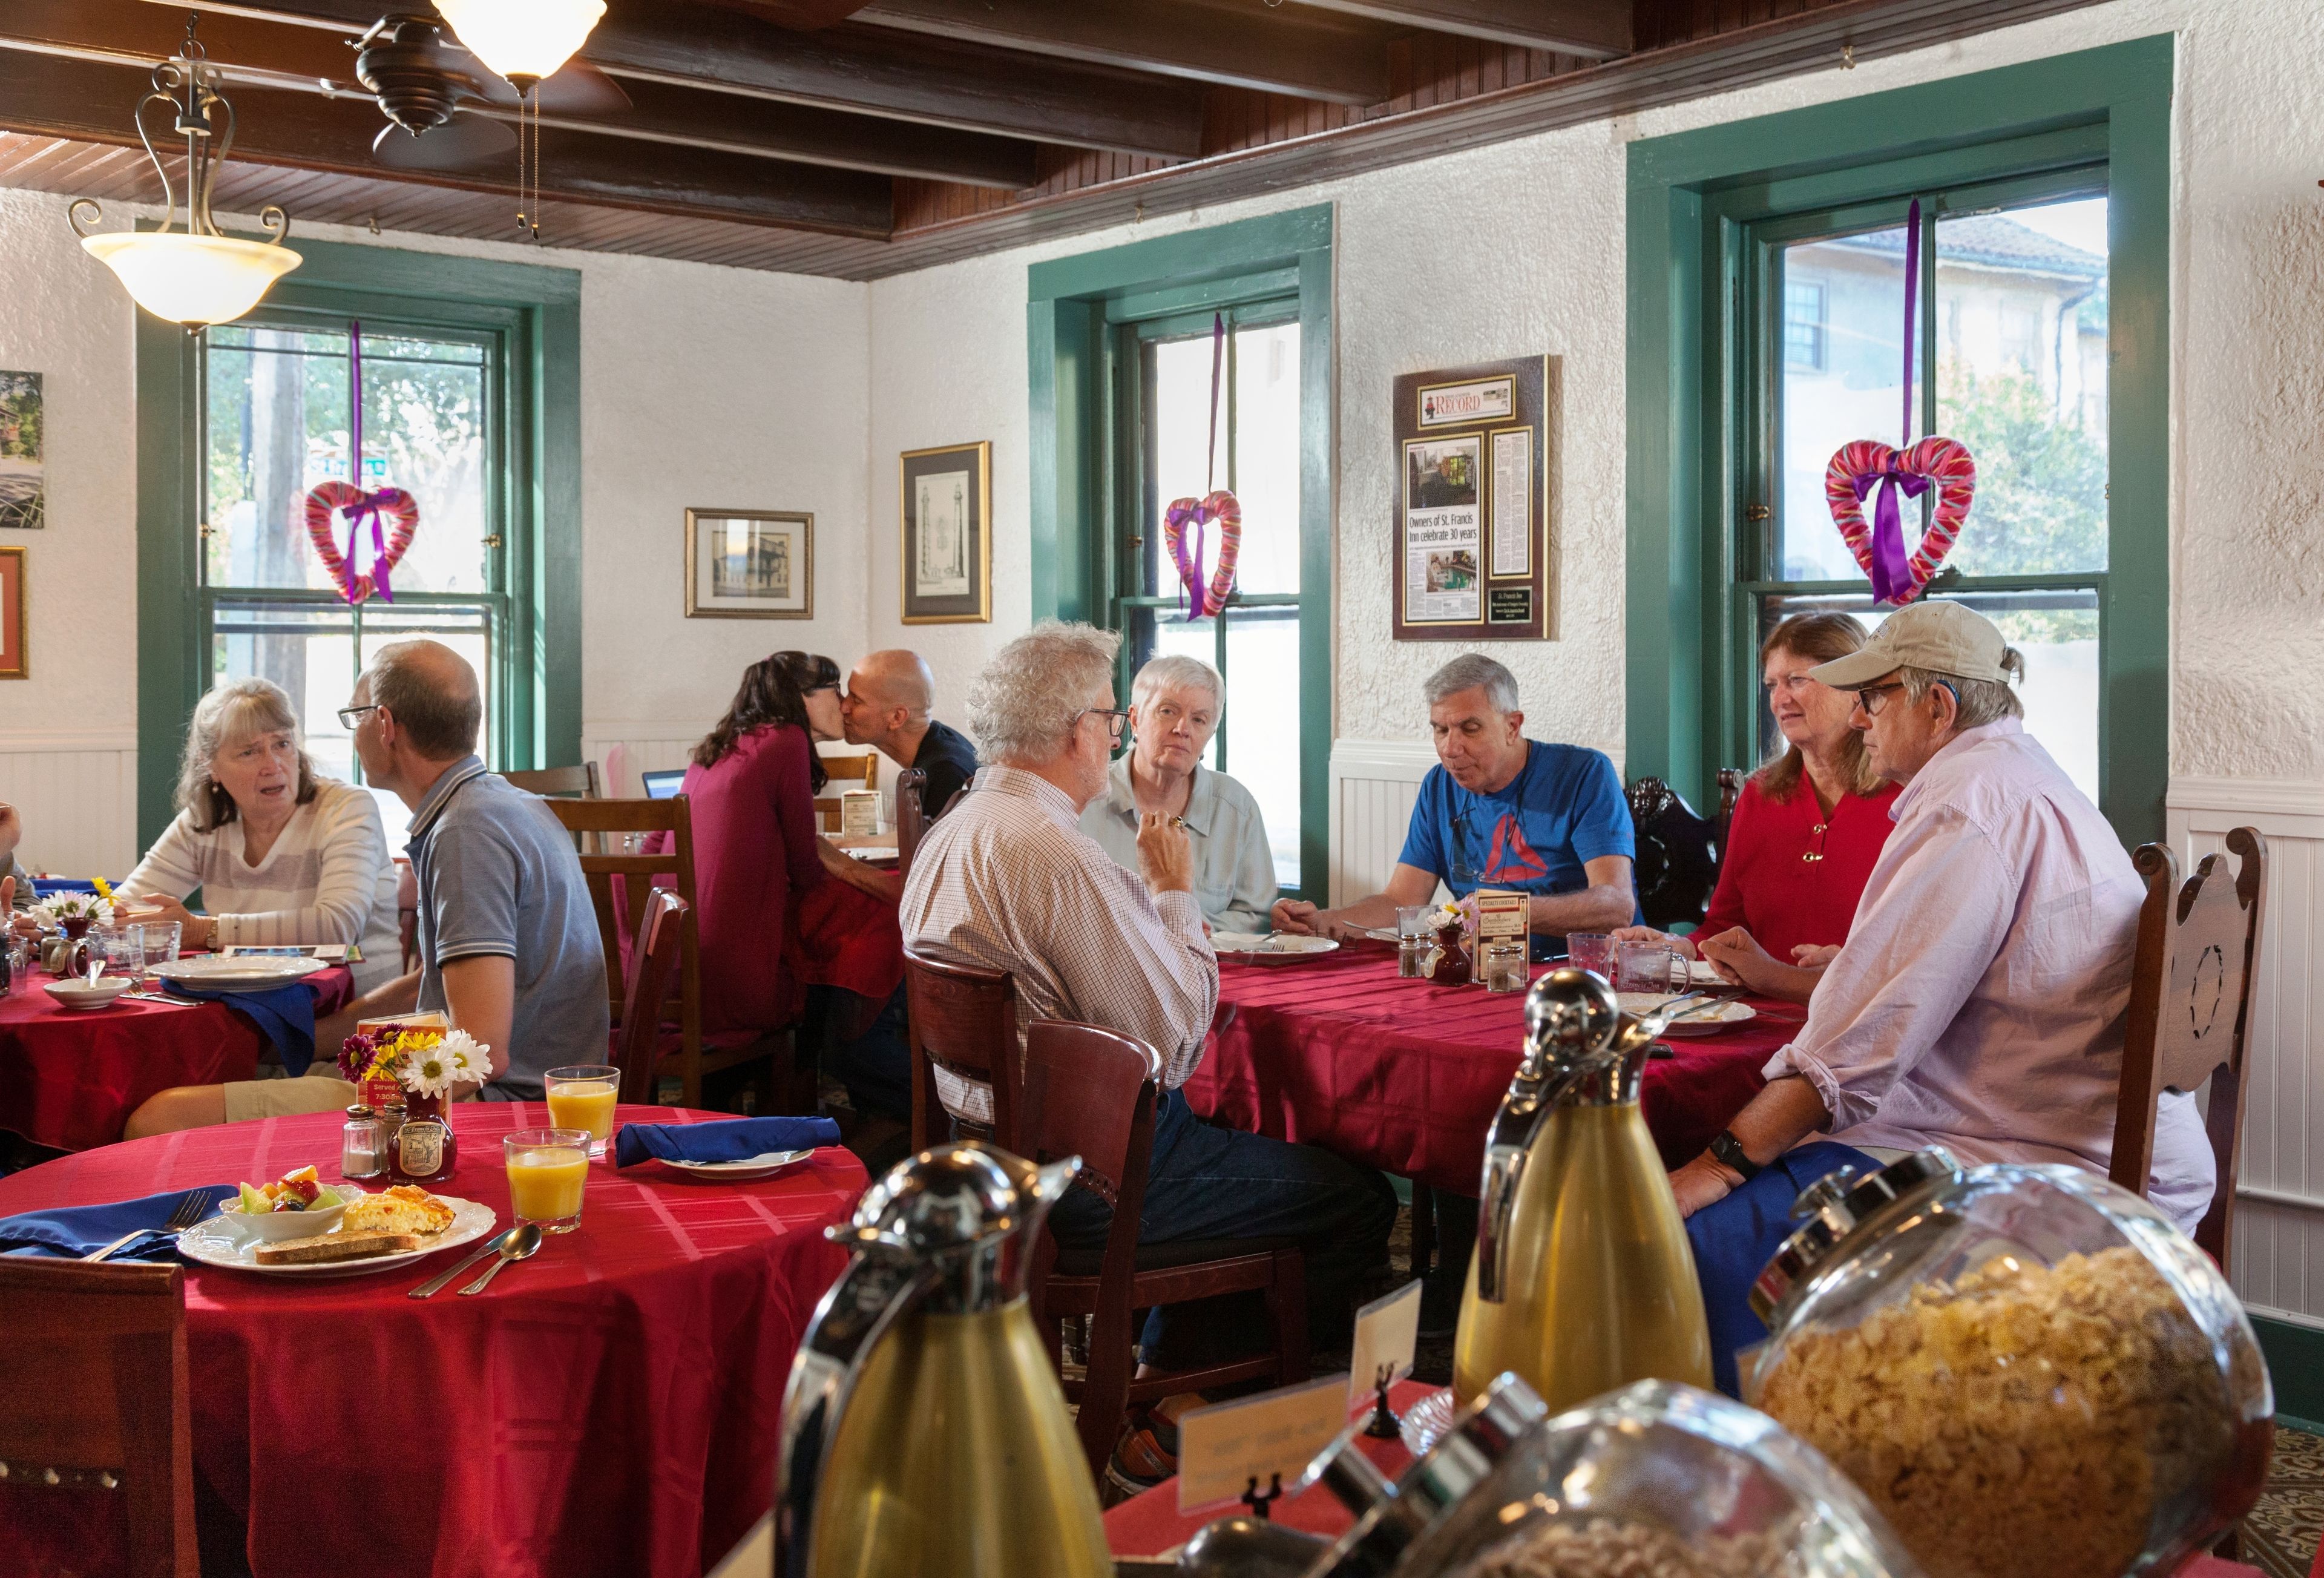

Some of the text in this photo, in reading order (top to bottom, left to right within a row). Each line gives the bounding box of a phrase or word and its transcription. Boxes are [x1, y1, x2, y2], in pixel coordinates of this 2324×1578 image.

[1410, 517, 1433, 528] Owners
[1434, 514, 1440, 526] of
[1451, 511, 1473, 525] Francis
[1410, 528, 1477, 542] Inn celebrate 30 years
